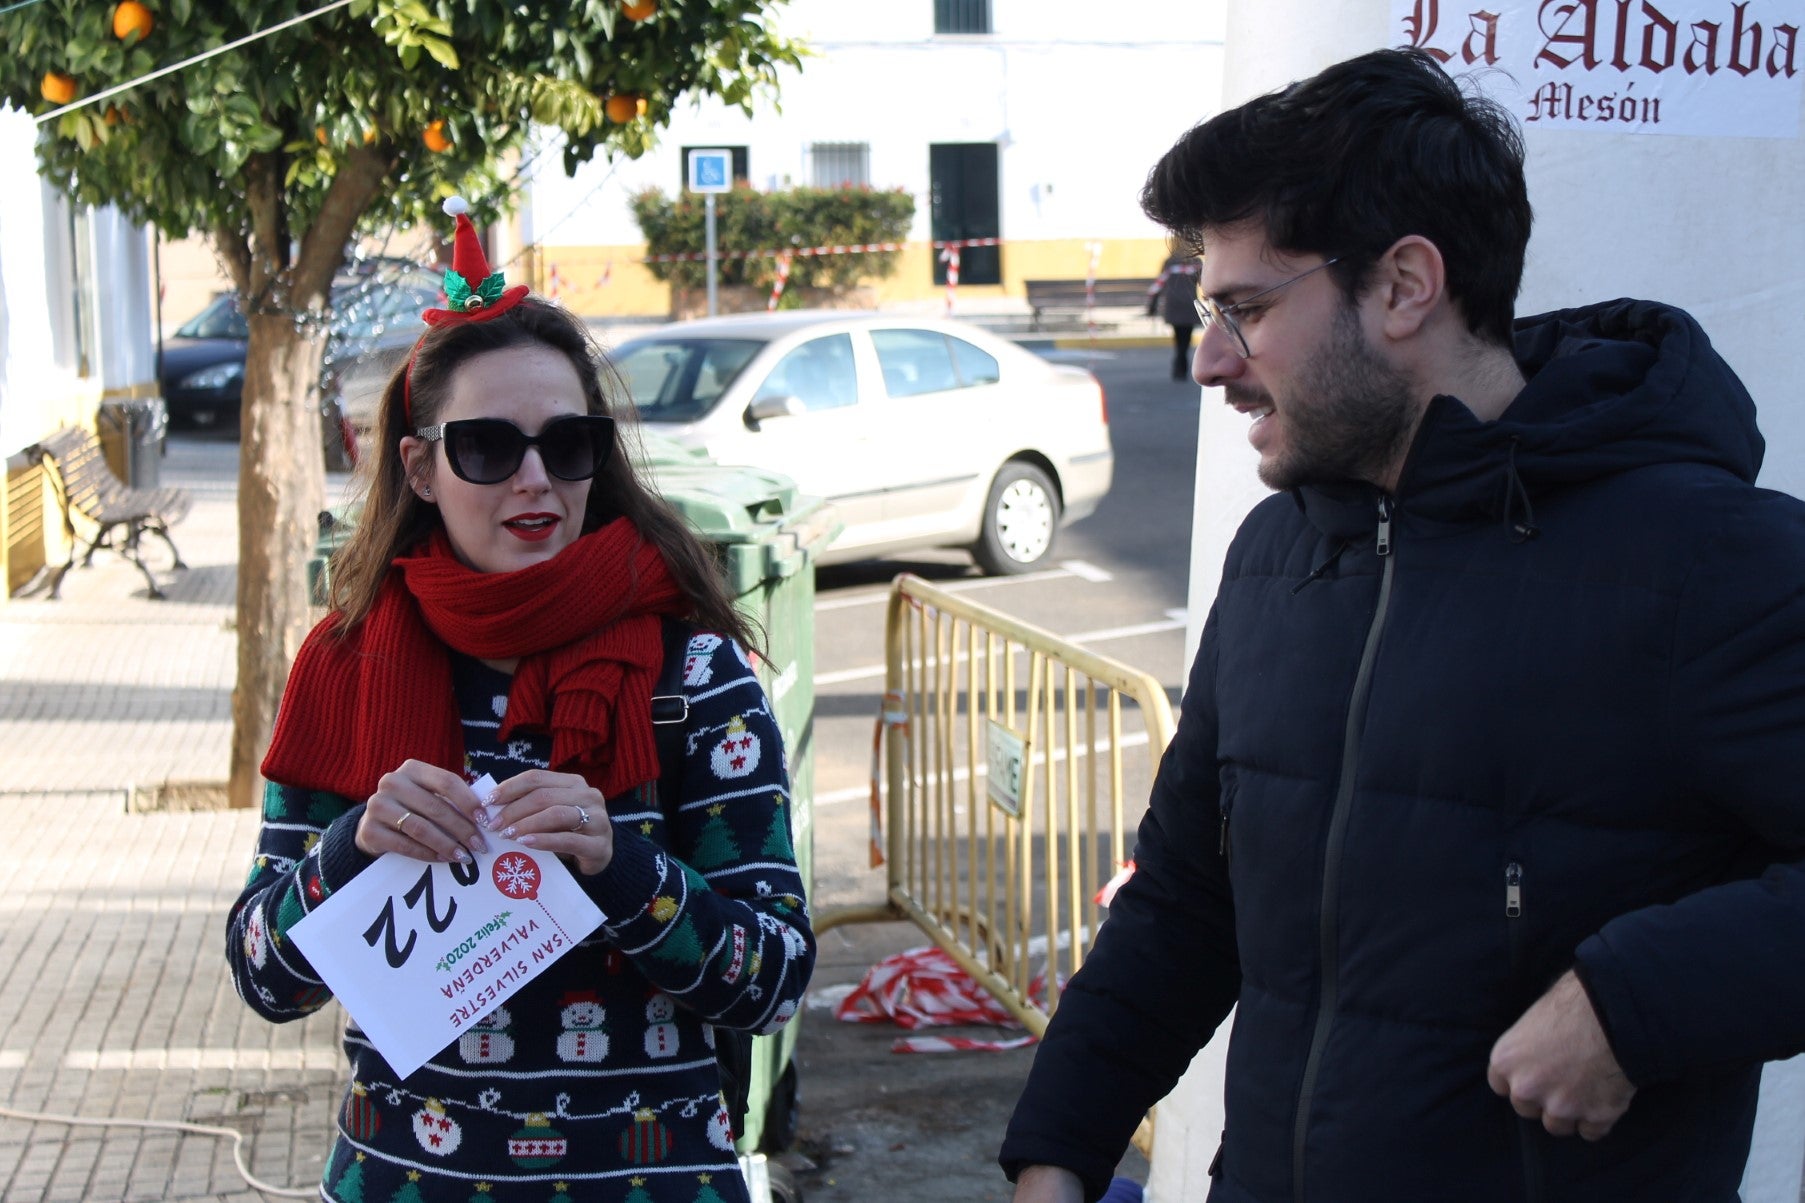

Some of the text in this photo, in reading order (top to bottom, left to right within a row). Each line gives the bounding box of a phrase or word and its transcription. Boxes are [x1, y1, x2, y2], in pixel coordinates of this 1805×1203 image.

[1401, 0, 1801, 80] La Aldaba
[1525, 81, 1662, 124] Mesón
[440, 919, 540, 999] VALVERDEÑA
[446, 918, 501, 965] Feliz 2020
[449, 933, 563, 1028] SAN SILVESTRE
